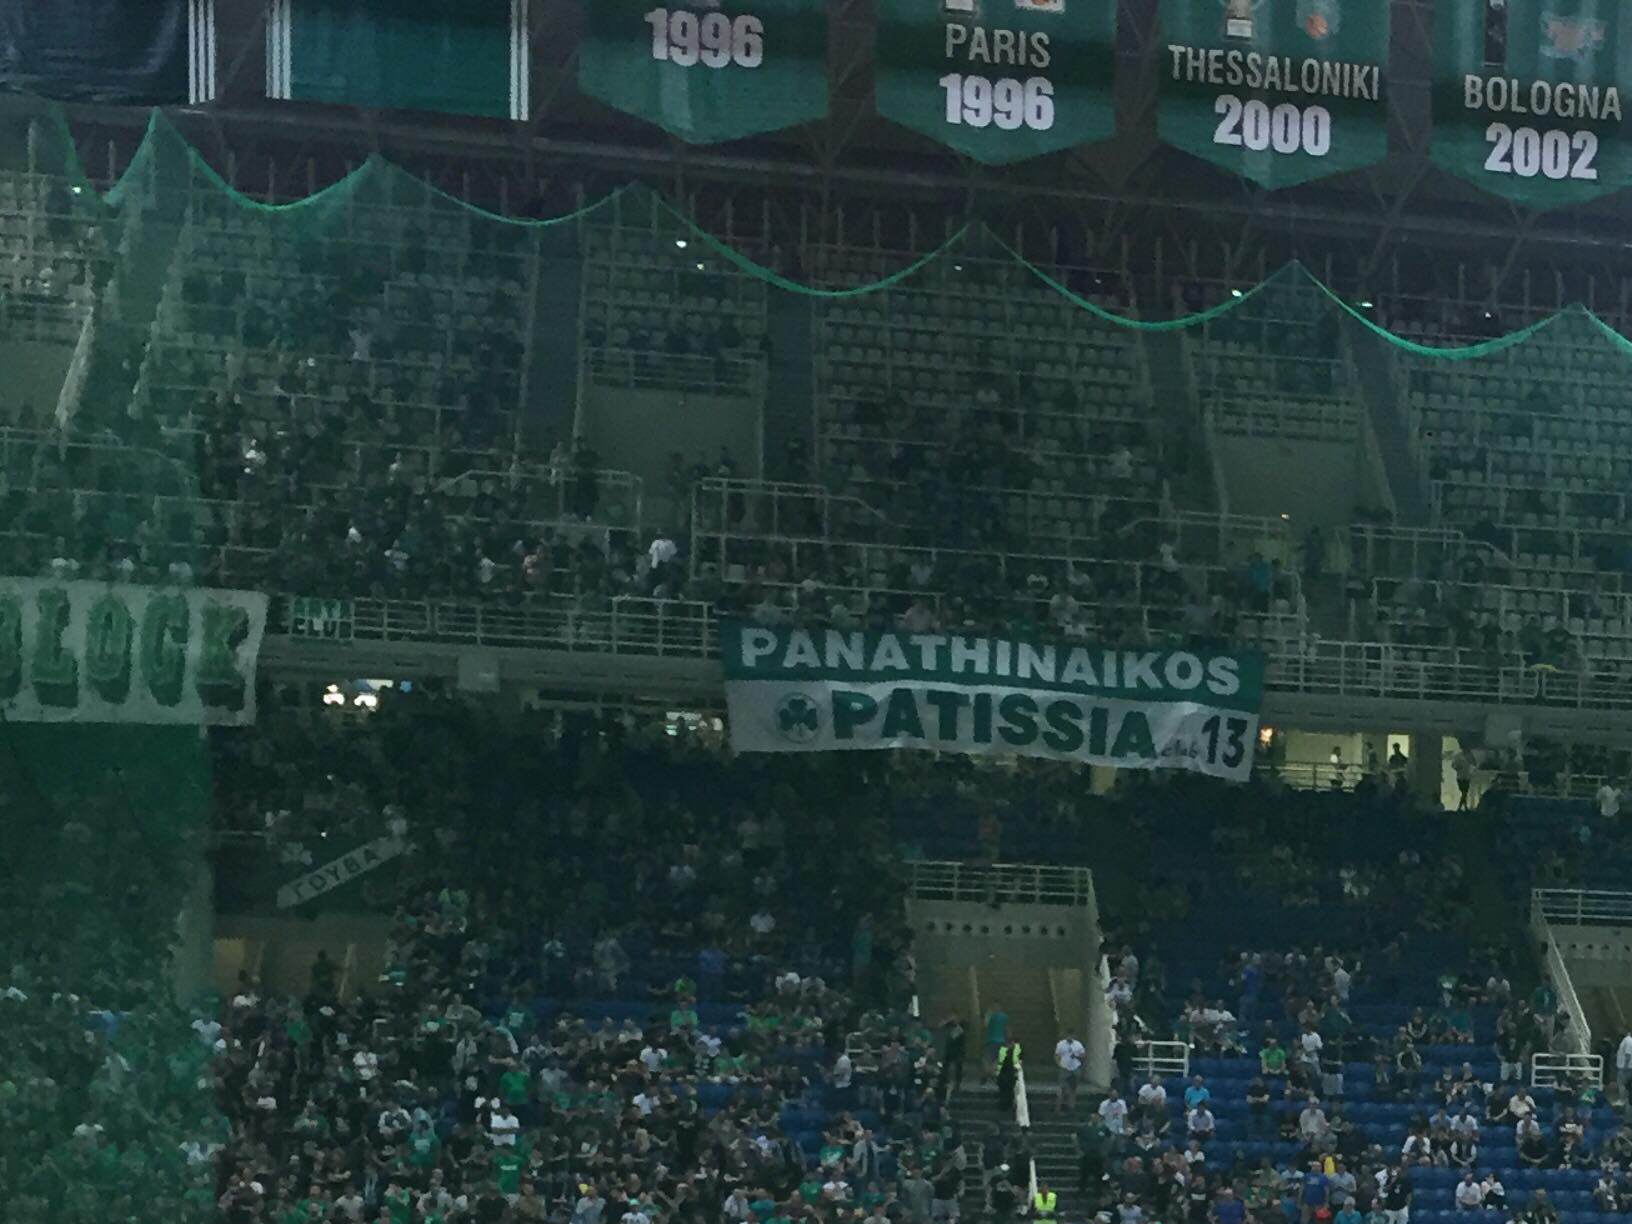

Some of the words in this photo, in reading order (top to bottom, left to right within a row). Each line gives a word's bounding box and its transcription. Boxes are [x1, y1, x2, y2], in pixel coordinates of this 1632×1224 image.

[644, 8, 763, 68] 1996
[944, 23, 1051, 68] PARIS
[939, 73, 1055, 130] 1996
[1168, 44, 1380, 101] THESSALONIKI
[1464, 75, 1621, 121] BOLOGNA
[1213, 94, 1331, 156] 2000
[1484, 122, 1600, 180] 2002
[740, 628, 1241, 695] PANATHINAIKOS
[831, 688, 1155, 760] PATISSIA
[1200, 715, 1249, 769] 13
